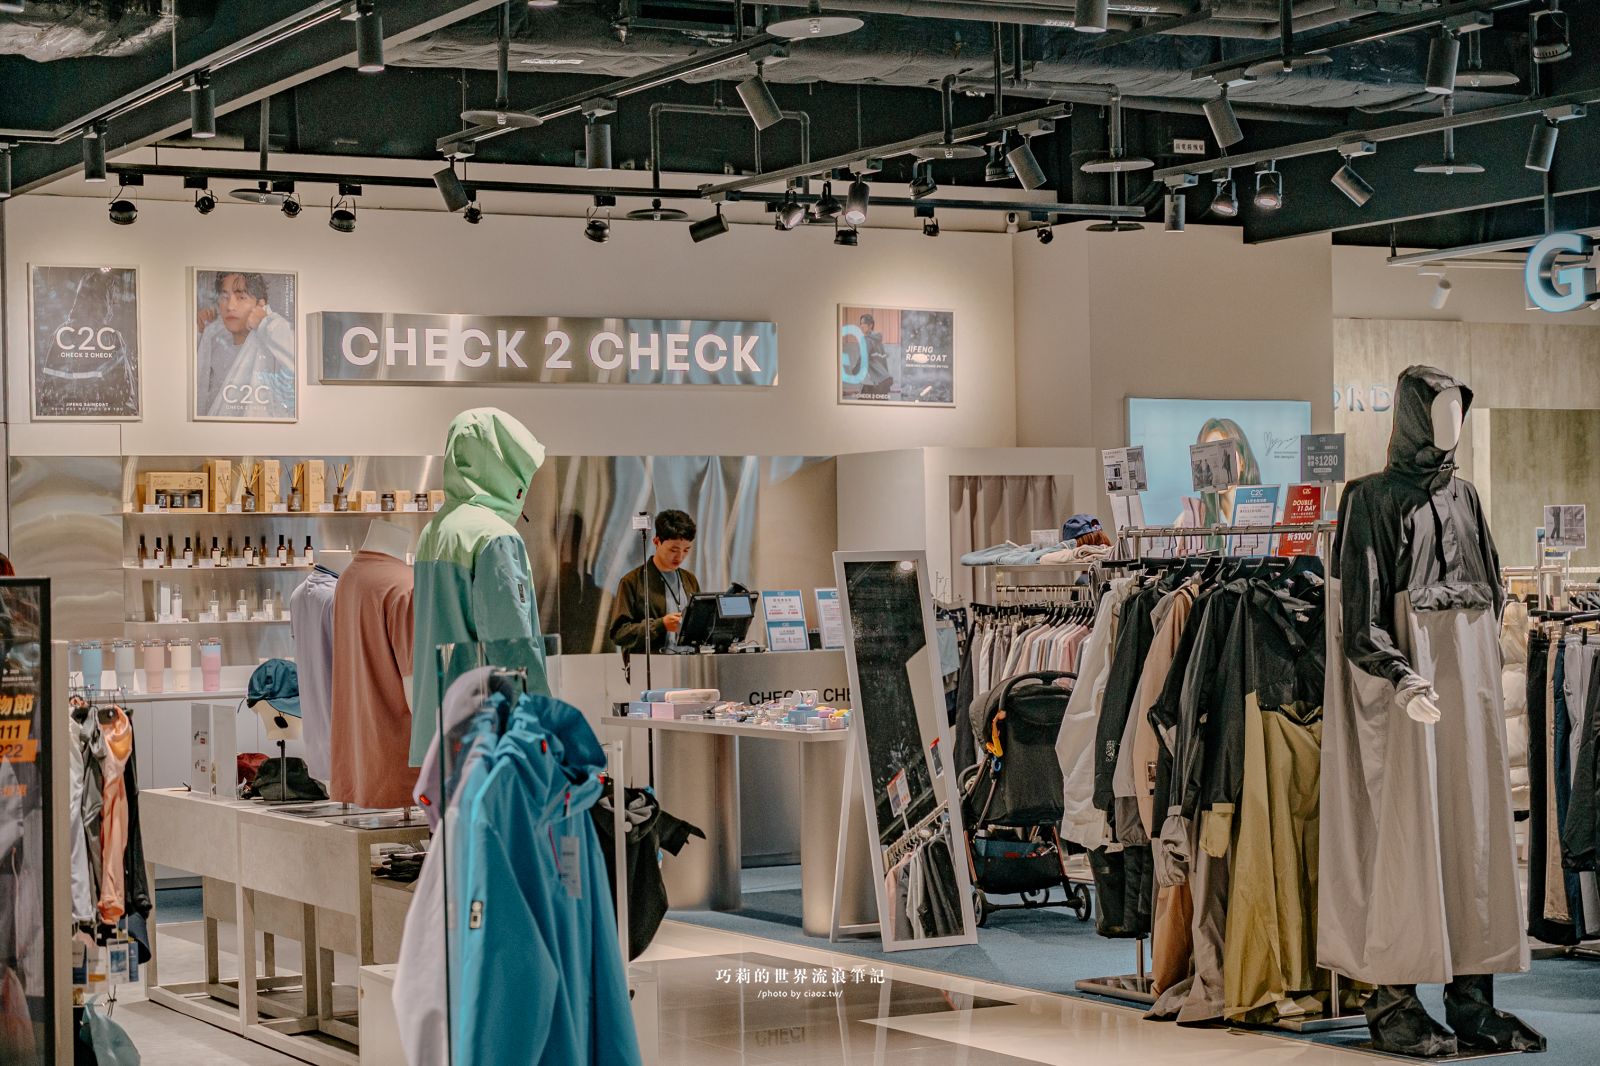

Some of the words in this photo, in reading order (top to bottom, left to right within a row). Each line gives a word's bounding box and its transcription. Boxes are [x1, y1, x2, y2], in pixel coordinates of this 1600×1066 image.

[1524, 233, 1593, 313] G
[55, 326, 116, 351] C2C
[341, 325, 528, 369] CHECK
[544, 330, 573, 369] 2
[589, 330, 762, 372] CHECK
[905, 345, 934, 353] JIFENG
[222, 384, 270, 405] C2C
[1314, 455, 1338, 466] $1280
